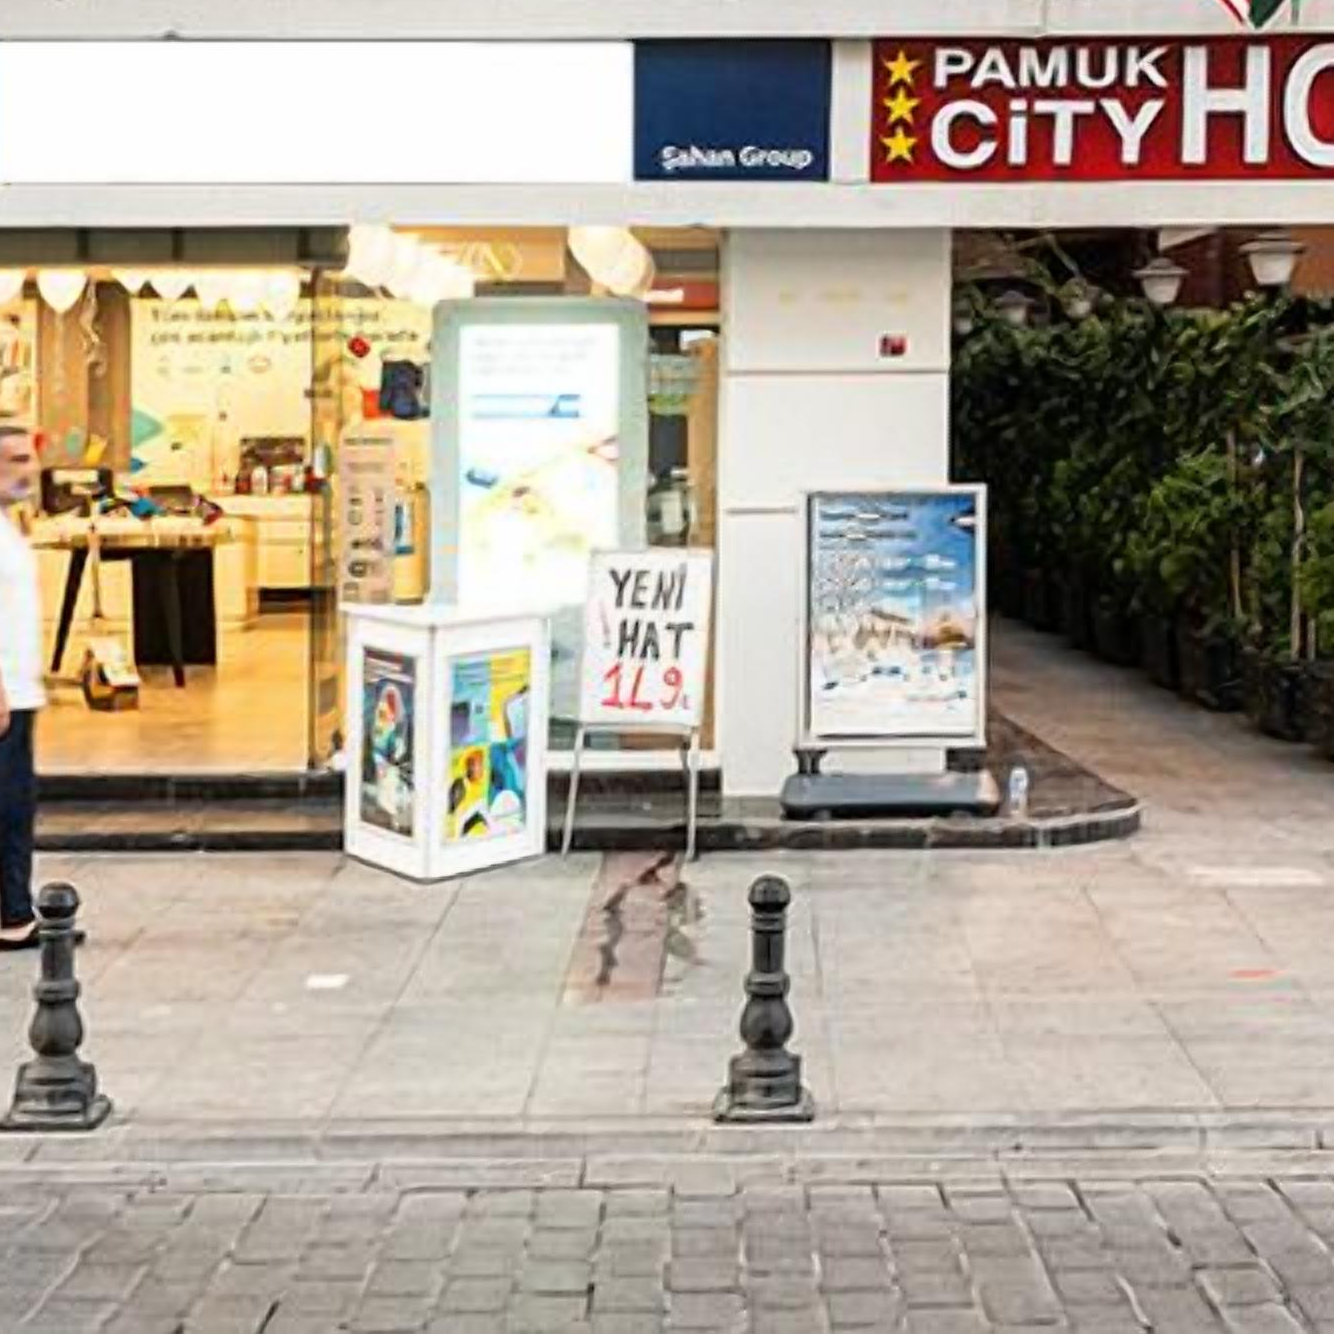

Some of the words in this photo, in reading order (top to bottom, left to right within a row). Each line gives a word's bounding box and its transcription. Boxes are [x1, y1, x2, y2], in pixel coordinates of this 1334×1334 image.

[933, 46, 1169, 90] PAMUK
[738, 145, 814, 171] Group
[618, 618, 695, 661] HAT
